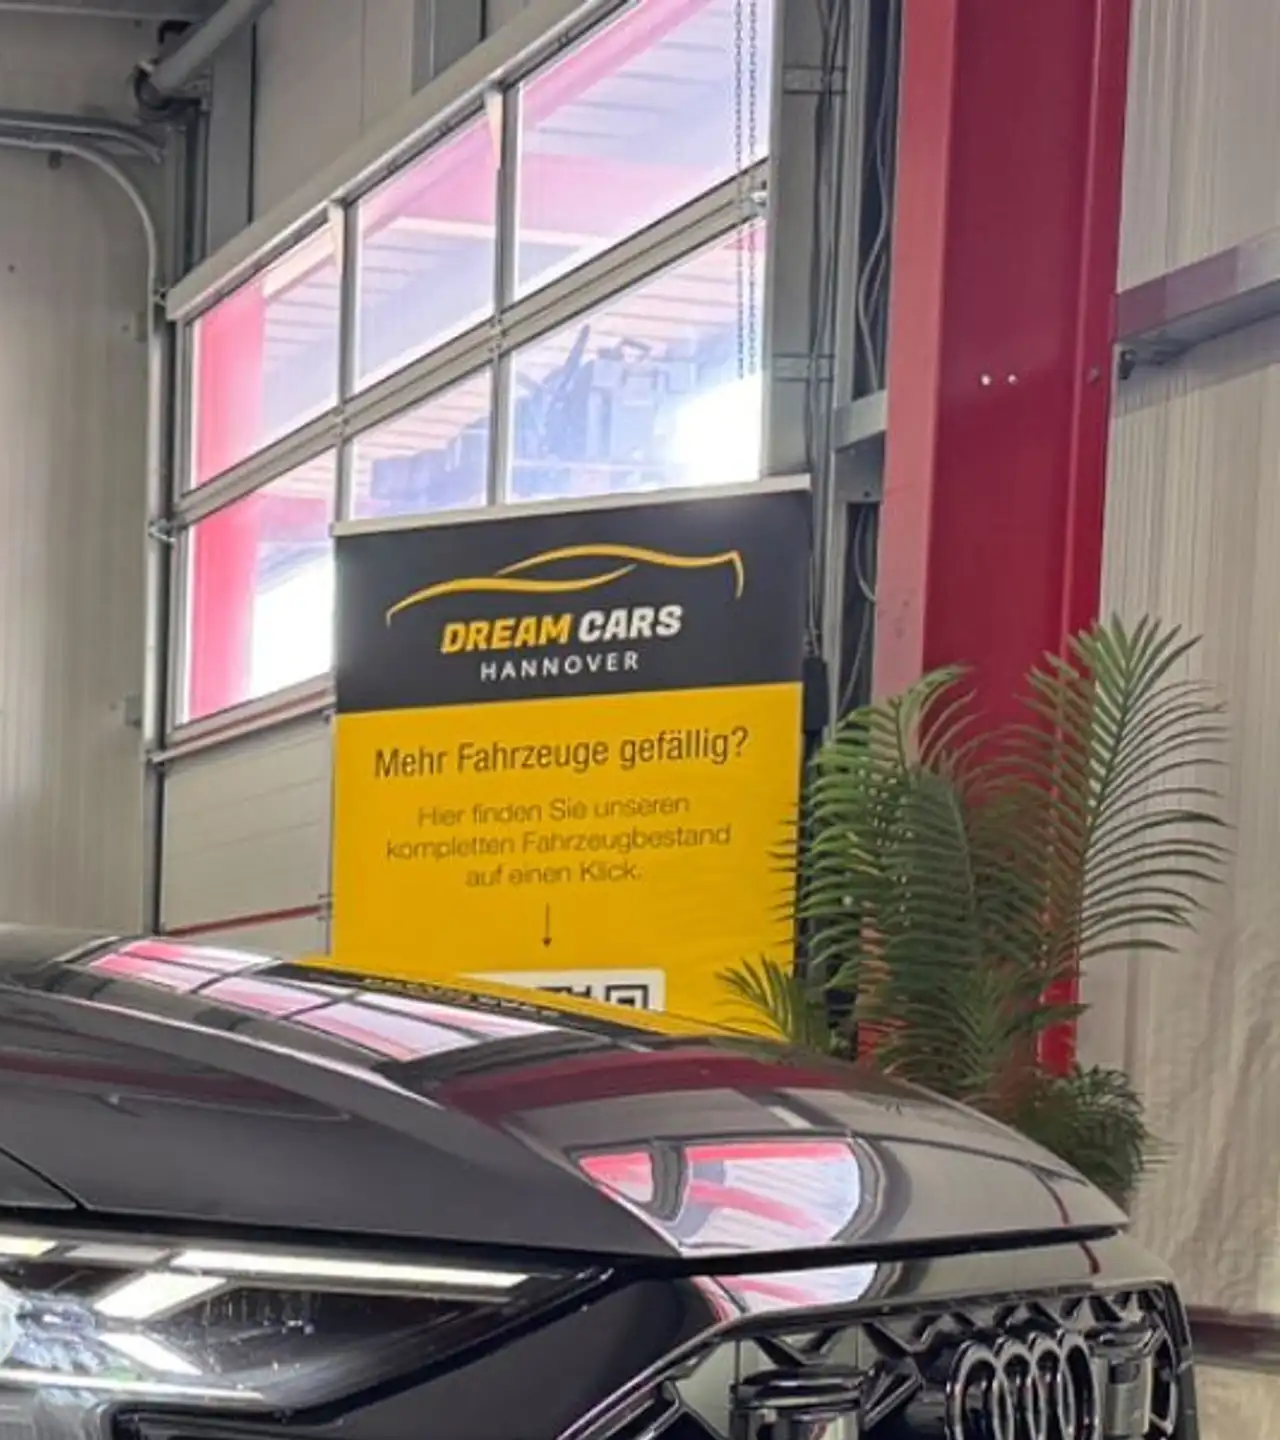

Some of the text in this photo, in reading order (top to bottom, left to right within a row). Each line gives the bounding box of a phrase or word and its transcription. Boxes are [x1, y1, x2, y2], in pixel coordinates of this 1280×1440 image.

[440, 604, 684, 654] DREAM CARS
[480, 652, 639, 681] HANNOVER
[375, 726, 749, 778] Mehr Fahrzeuge gefällig?
[417, 794, 690, 827] Hier finden Sie unseren
[386, 825, 731, 862] kompletten Fahrzeugbestand
[466, 857, 642, 887] auf einen Klick.
